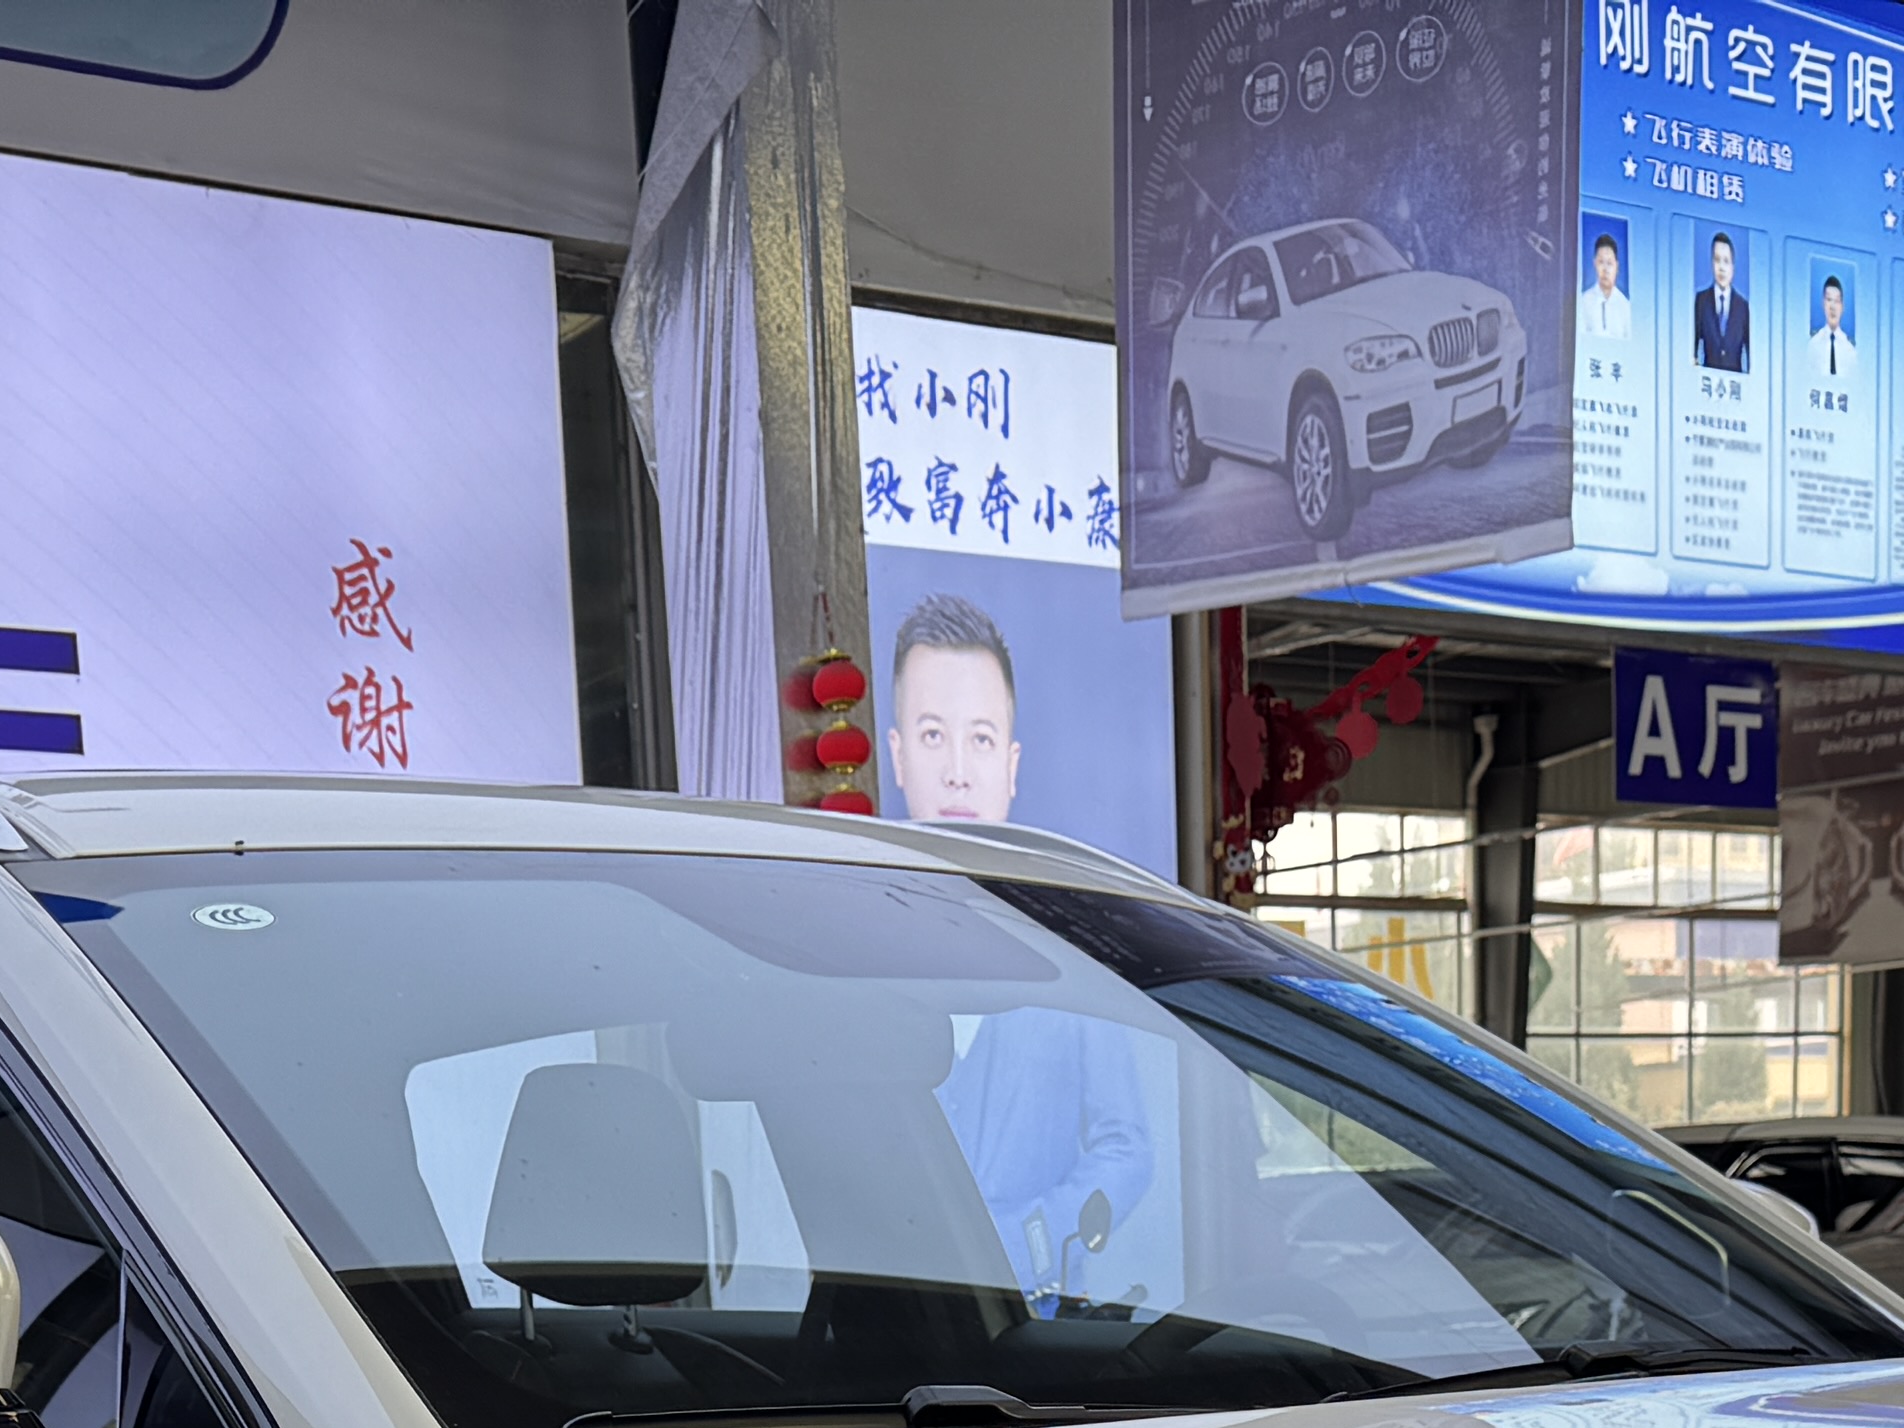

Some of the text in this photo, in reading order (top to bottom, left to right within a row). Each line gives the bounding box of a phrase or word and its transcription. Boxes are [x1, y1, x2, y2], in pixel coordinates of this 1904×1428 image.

[1645, 112, 1794, 174] 飞行表演体验
[1645, 158, 1746, 203] 飞机租赁
[327, 538, 413, 772] 感谢
[1627, 673, 1764, 784] A厅
